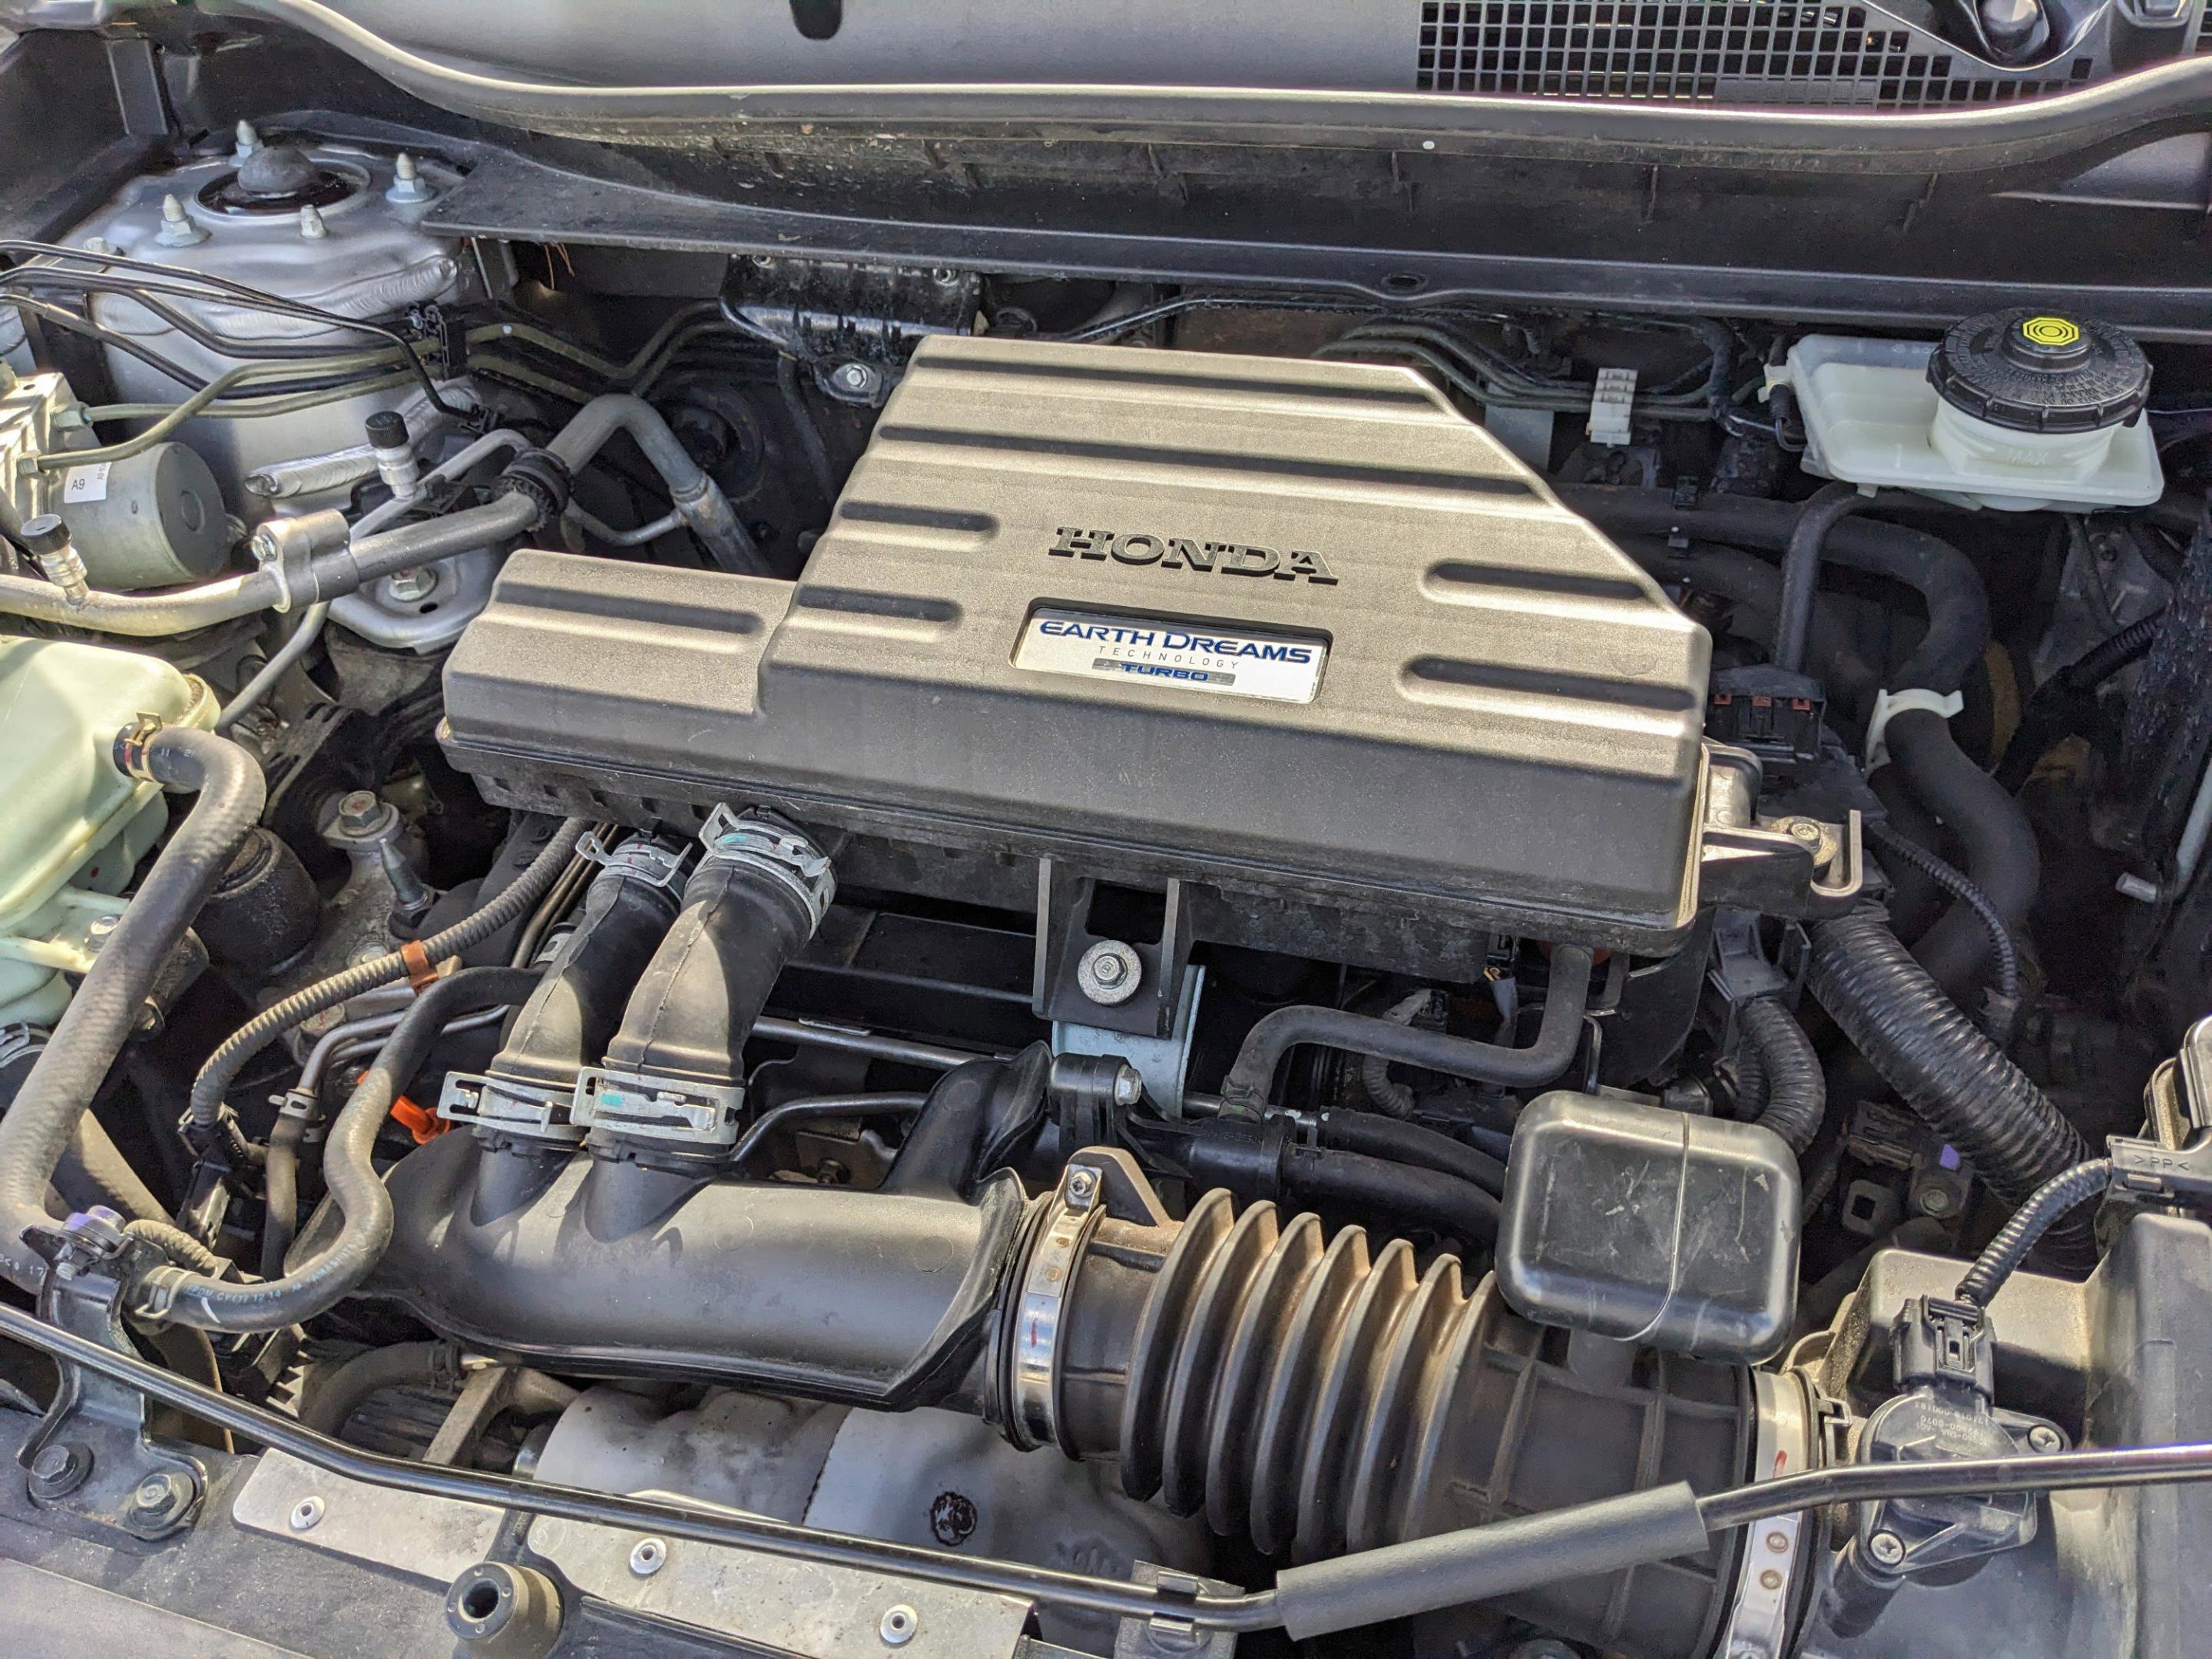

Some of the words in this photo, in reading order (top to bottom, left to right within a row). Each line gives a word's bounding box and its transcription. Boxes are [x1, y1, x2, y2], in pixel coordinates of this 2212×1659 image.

[71, 478, 85, 491] A9
[1048, 525, 1339, 586] HONDA
[1039, 620, 1155, 647] EARTH
[1163, 631, 1313, 664] DREAMS
[1098, 645, 1240, 670] TECHNOLOGY
[1121, 663, 1210, 682] TURBO
